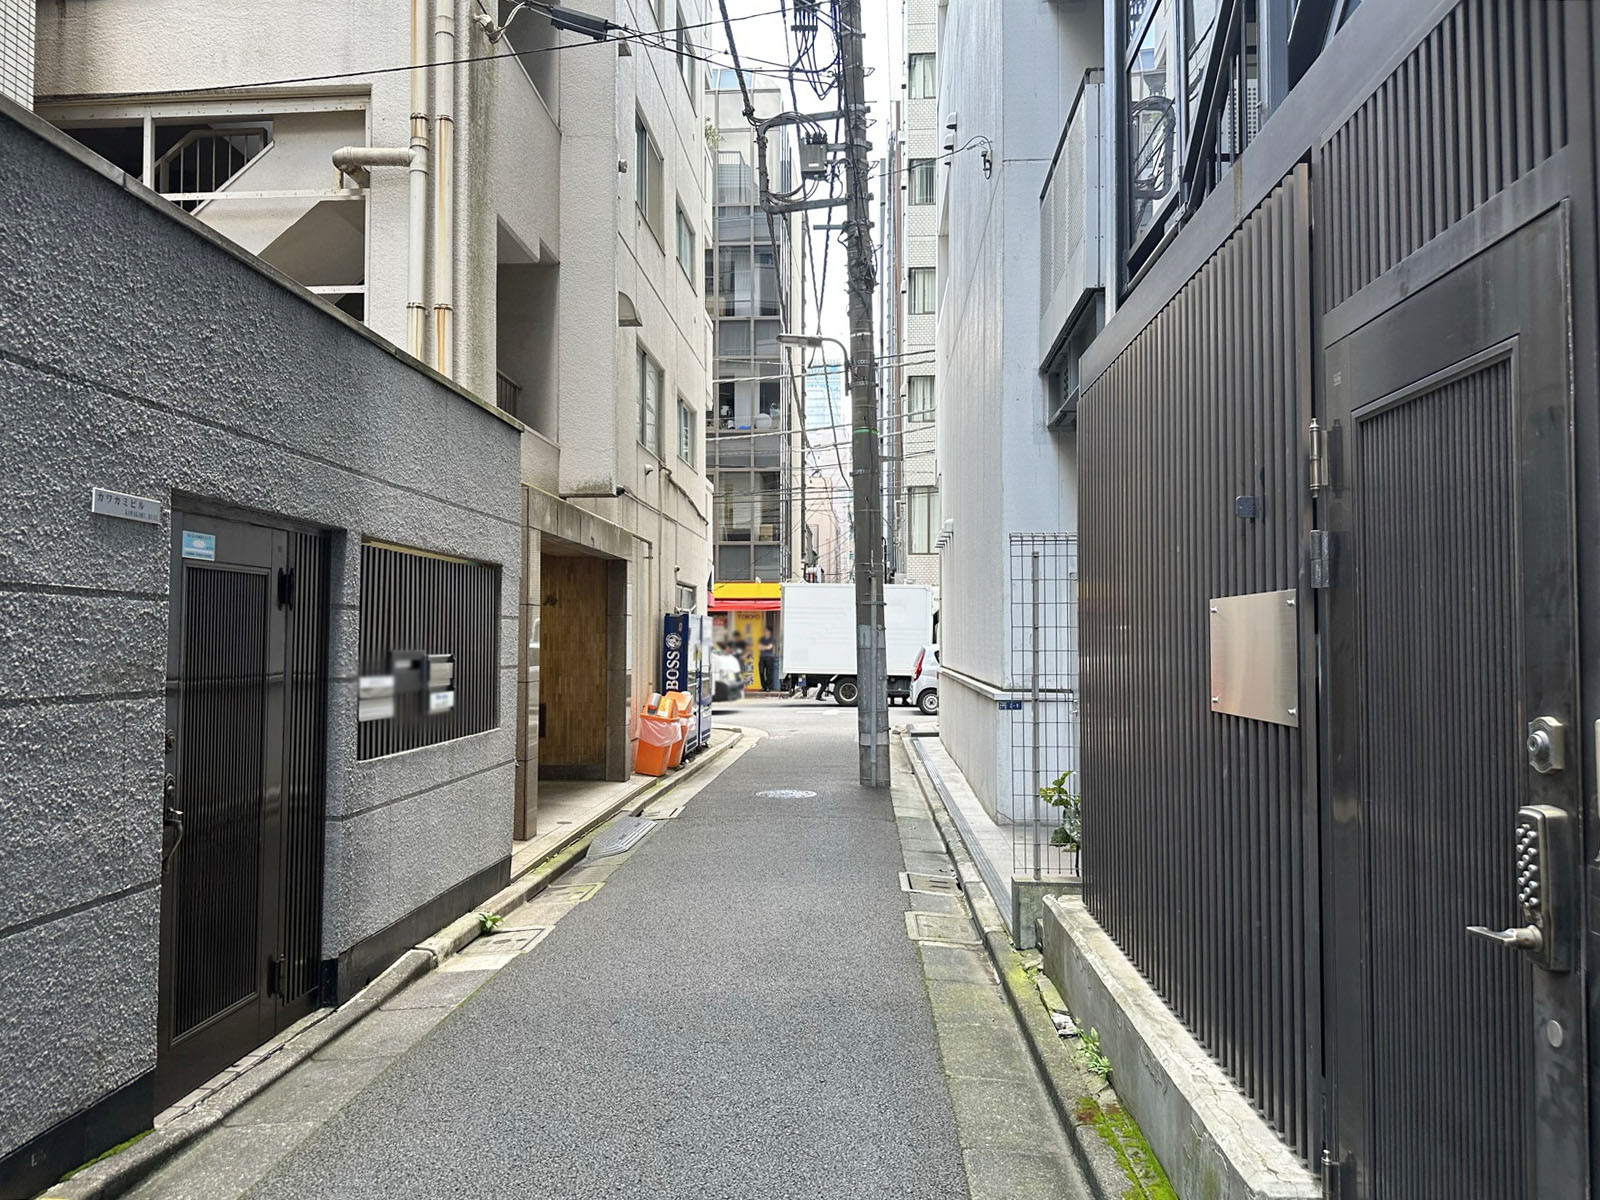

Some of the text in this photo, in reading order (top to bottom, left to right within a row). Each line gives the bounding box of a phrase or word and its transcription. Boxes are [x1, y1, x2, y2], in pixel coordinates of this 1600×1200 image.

[97, 494, 145, 510] カワカミビル
[666, 651, 680, 690] BOSS
